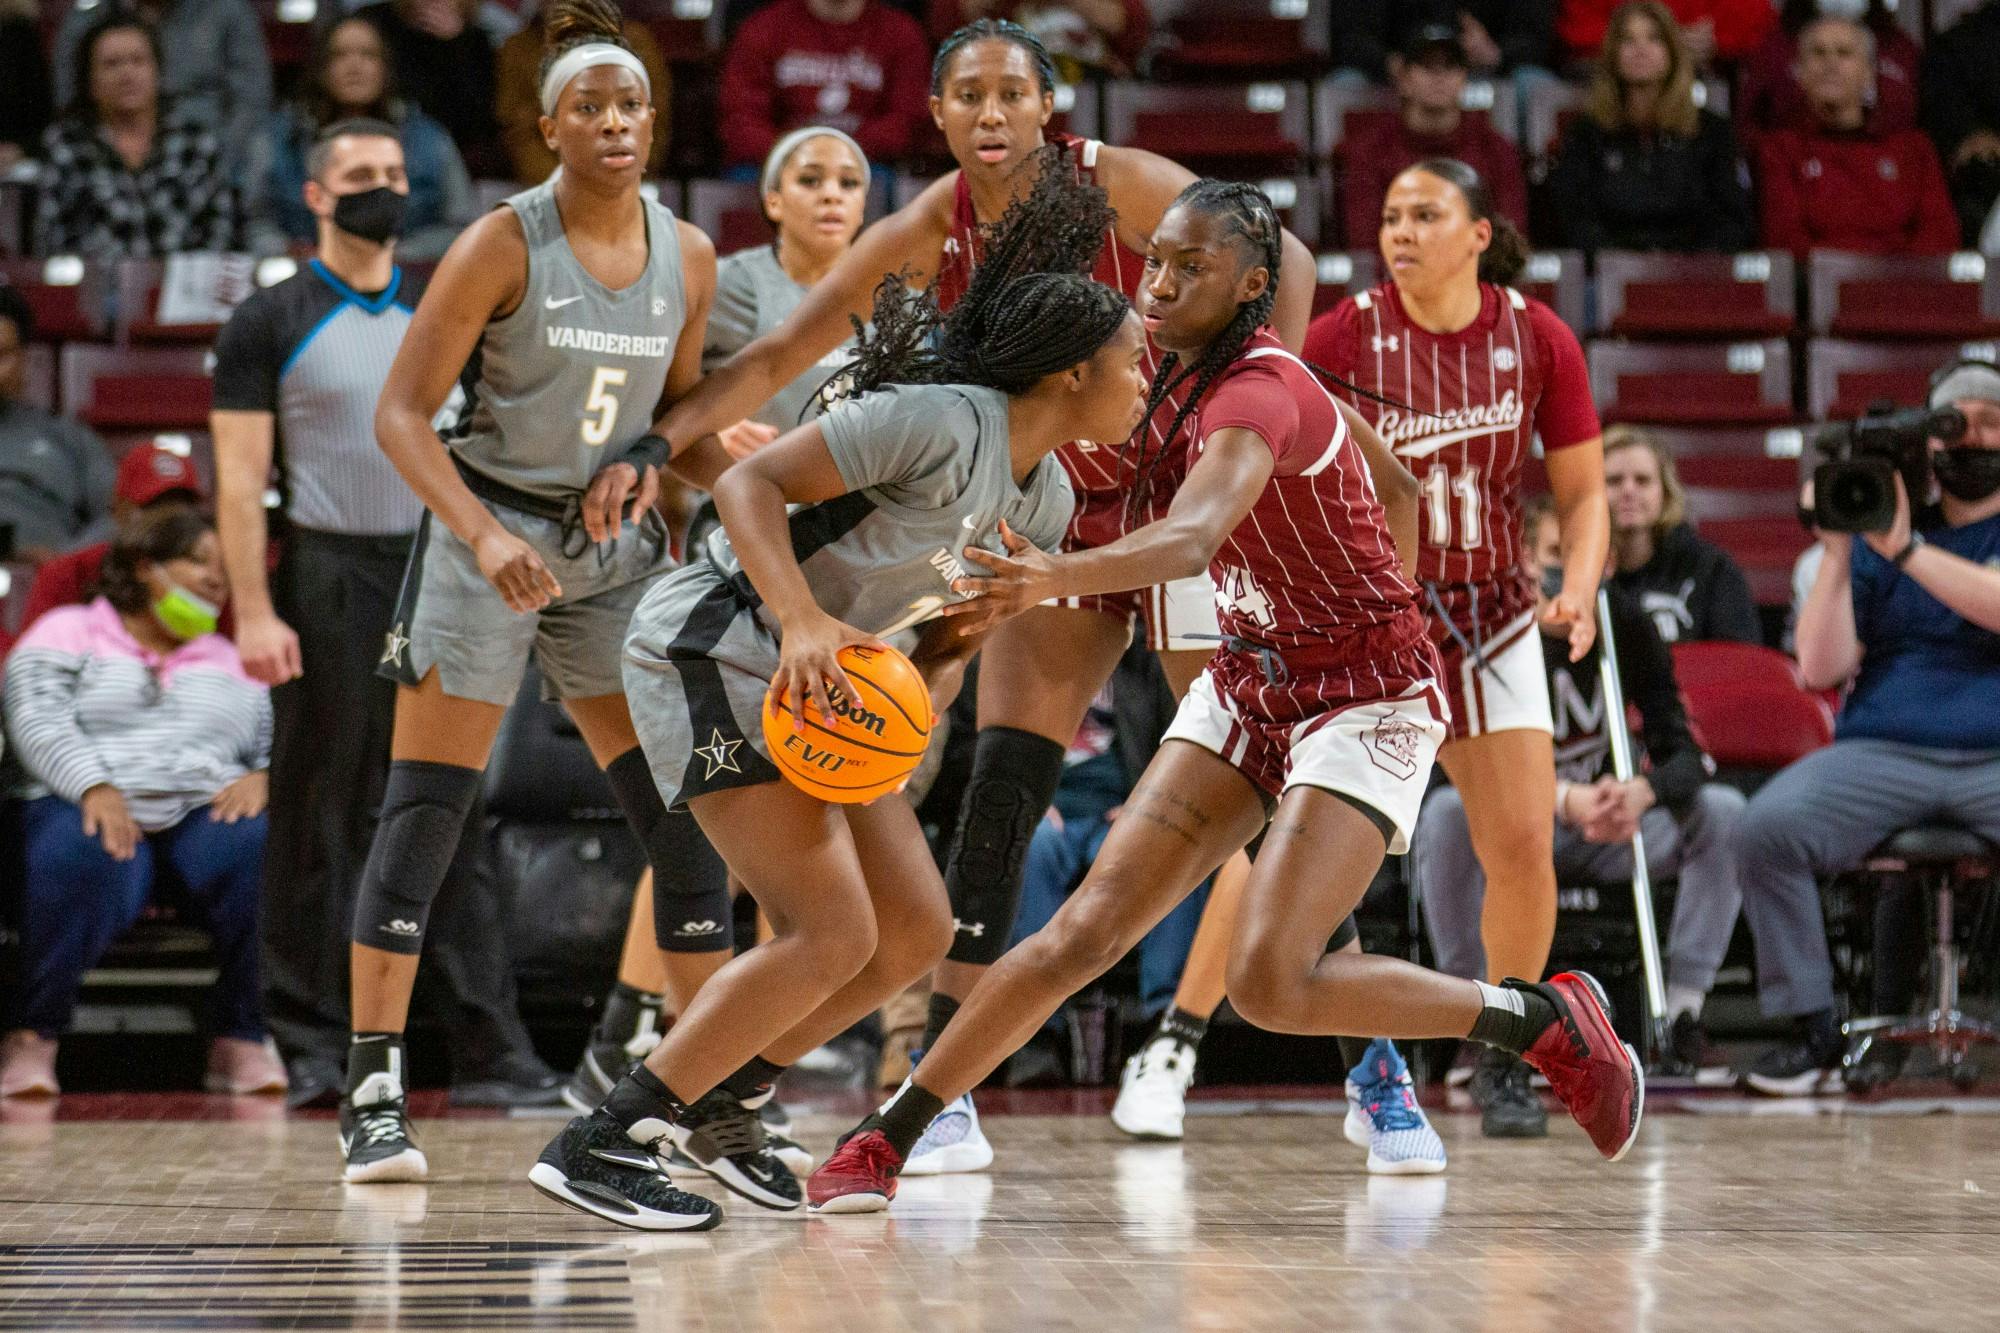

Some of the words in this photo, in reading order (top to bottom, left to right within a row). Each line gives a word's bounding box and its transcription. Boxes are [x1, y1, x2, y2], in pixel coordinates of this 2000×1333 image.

[546, 326, 669, 358] VANDERBILT
[580, 366, 628, 446] 5
[1376, 388, 1524, 450] Gamecocks
[1418, 464, 1483, 551] 11
[783, 733, 846, 772] EVO
